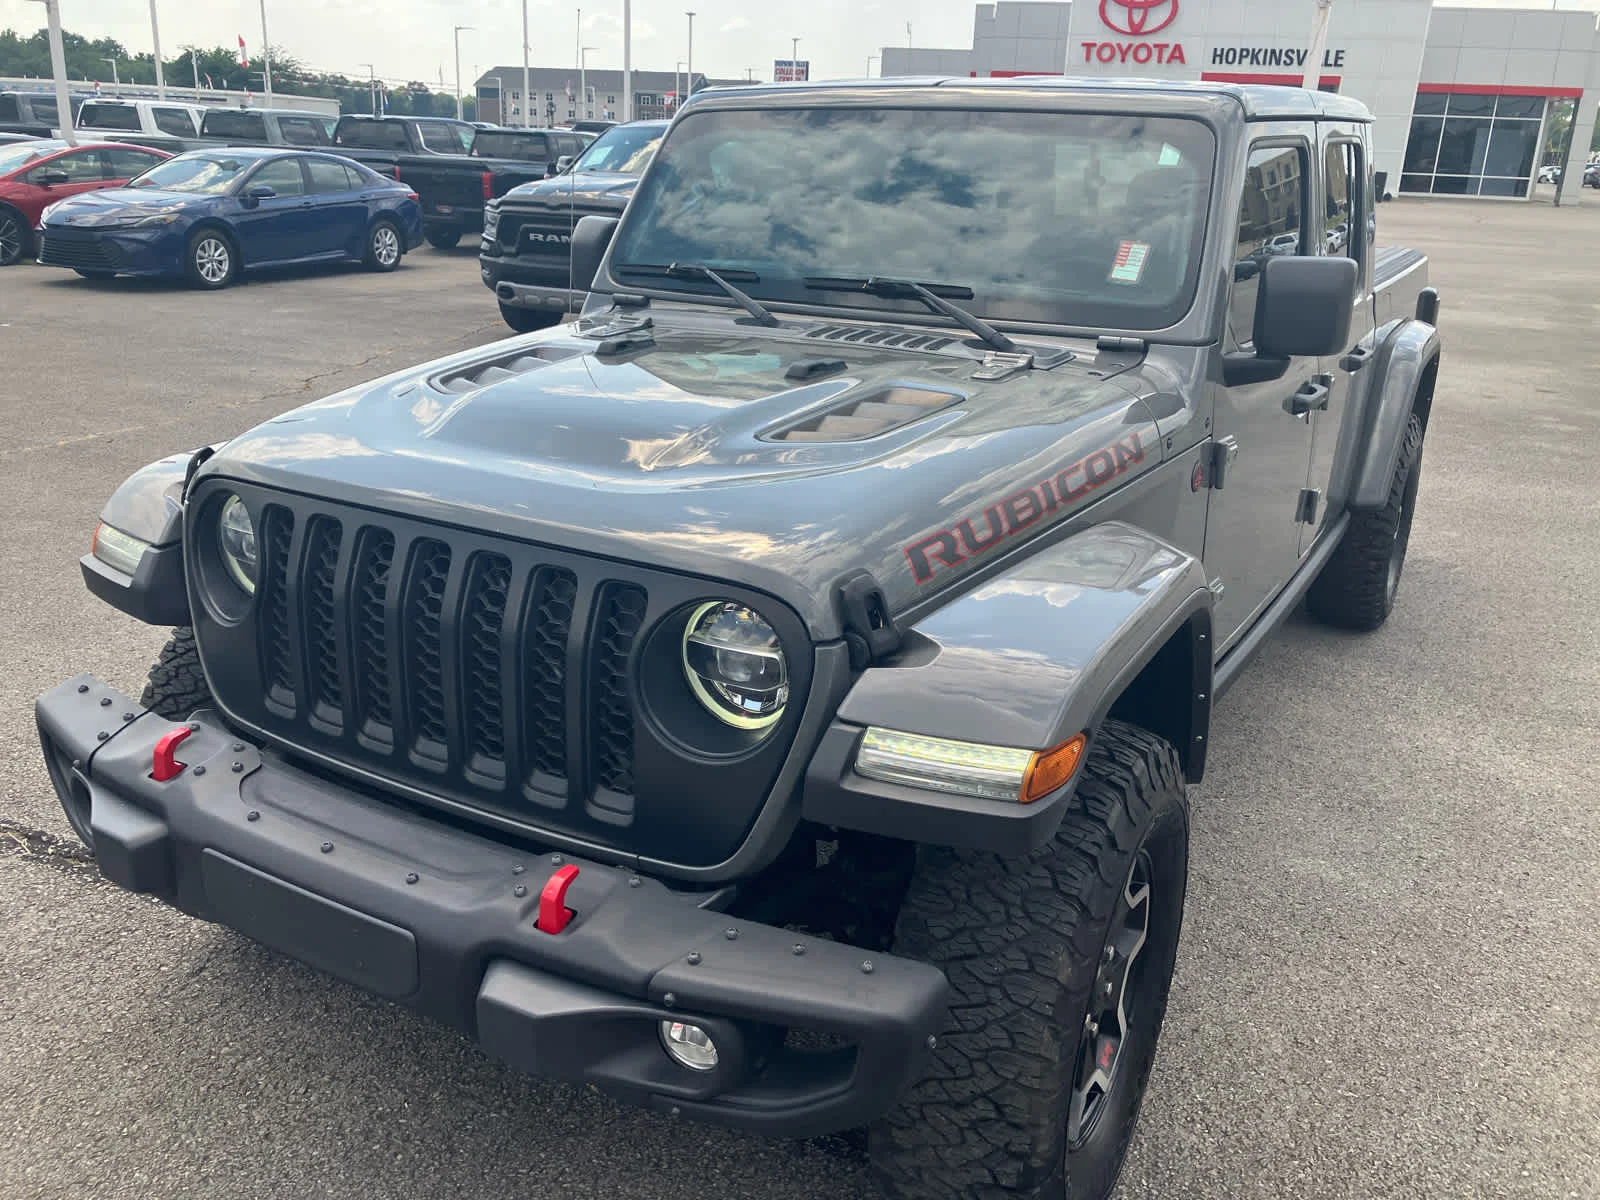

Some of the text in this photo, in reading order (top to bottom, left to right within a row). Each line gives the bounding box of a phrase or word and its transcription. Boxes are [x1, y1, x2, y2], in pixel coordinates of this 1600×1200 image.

[1081, 42, 1186, 64] TOYOTA
[1212, 47, 1345, 67] HOPKINSVLE
[903, 432, 1145, 585] RUBICON
